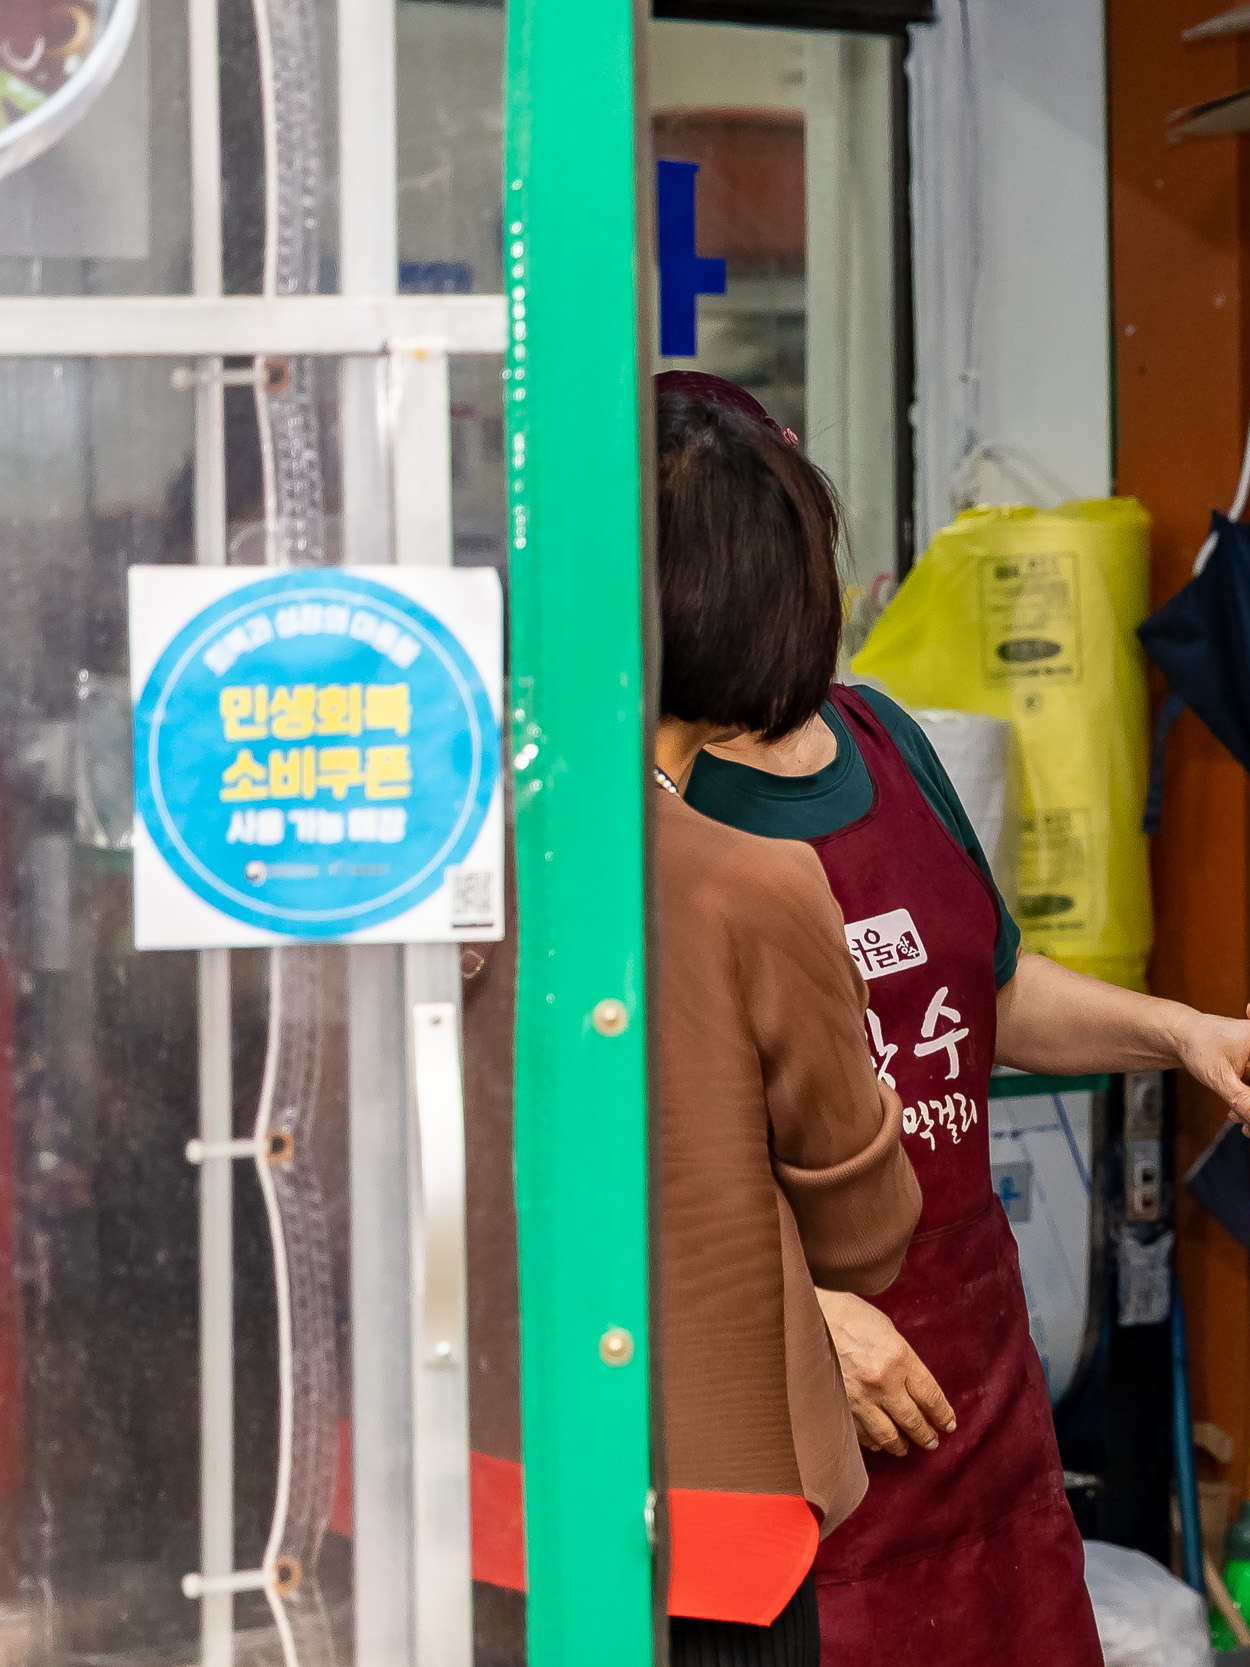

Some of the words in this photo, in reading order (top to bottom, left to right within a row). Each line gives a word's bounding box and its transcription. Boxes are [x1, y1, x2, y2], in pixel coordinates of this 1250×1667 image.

[220, 683, 411, 741] 민생회복
[220, 746, 411, 802] 소비쿠폰
[898, 935, 920, 958] 장수
[902, 1092, 978, 1151] 막걸리
